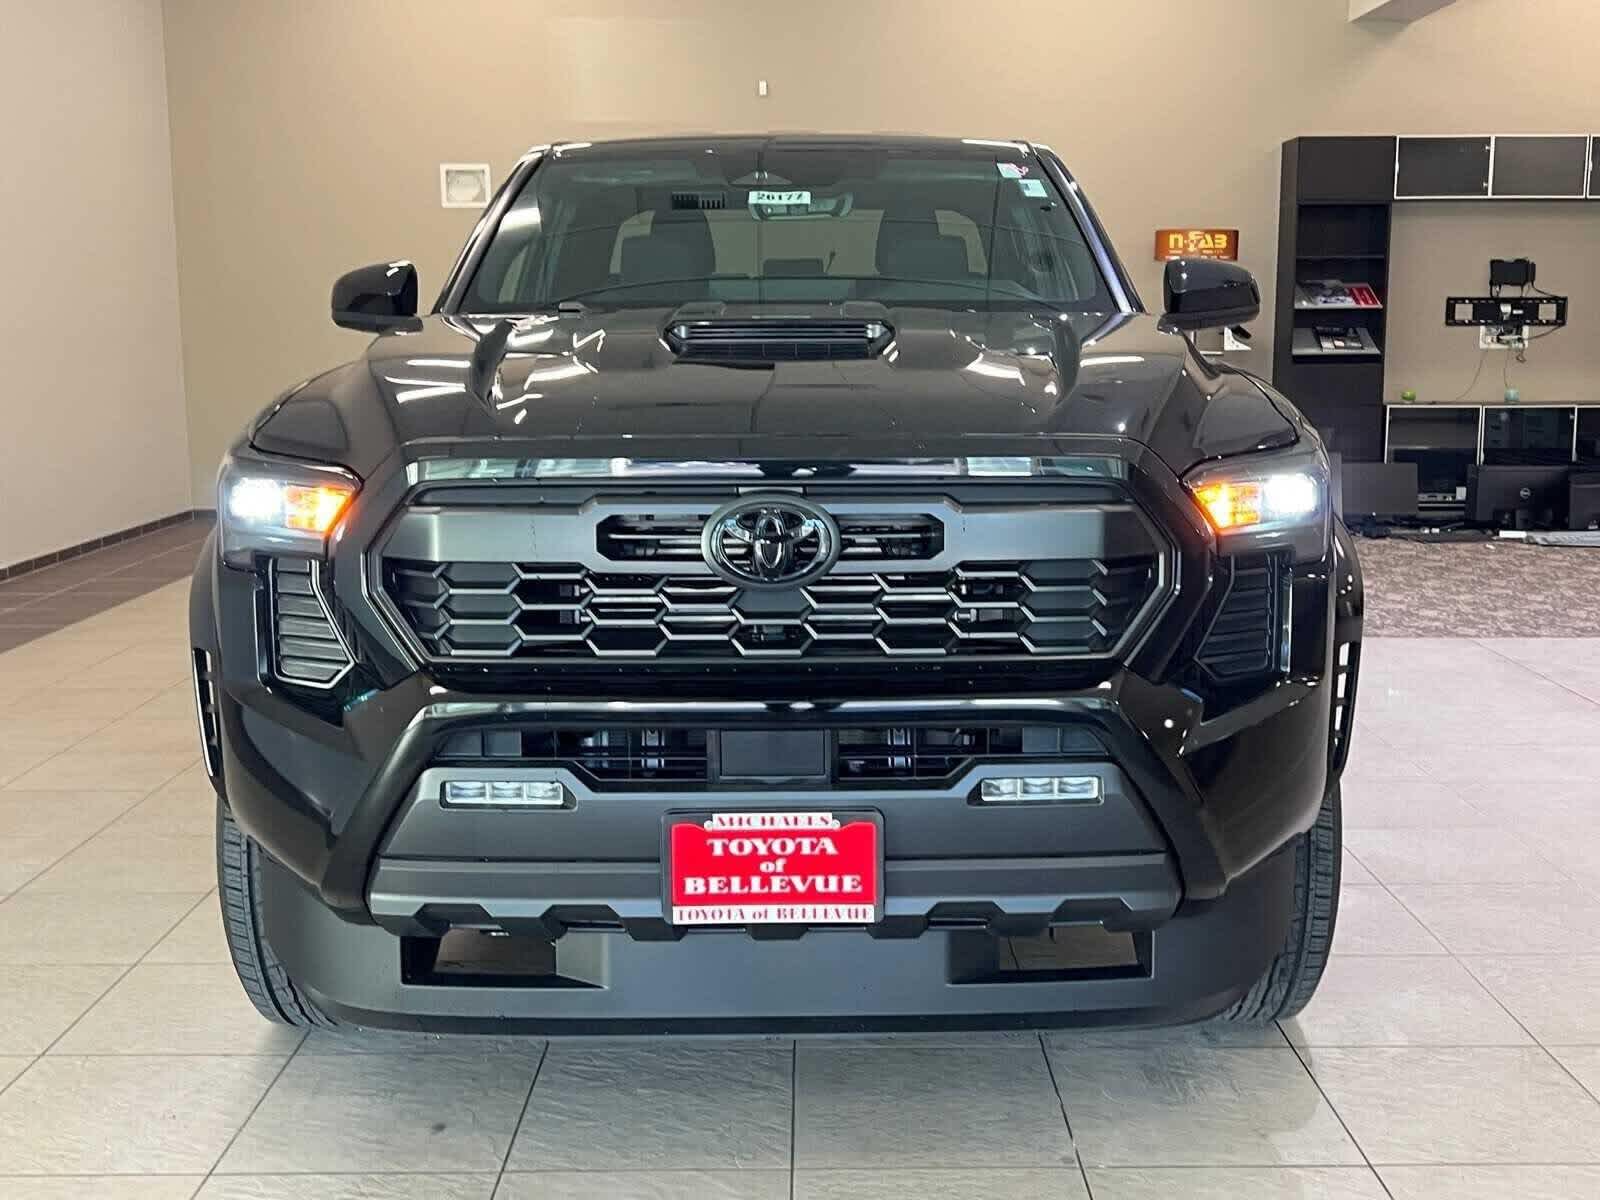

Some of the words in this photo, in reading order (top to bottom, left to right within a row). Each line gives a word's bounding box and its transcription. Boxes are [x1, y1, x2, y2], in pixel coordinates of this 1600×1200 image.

[716, 815, 830, 827] MICHAELS
[707, 838, 838, 856] TOYOTA
[759, 858, 786, 873] of
[684, 875, 862, 895] BELLEVUE
[678, 907, 746, 921] TOYOTA
[752, 907, 769, 920] of
[777, 906, 868, 920] BELLEVUE
